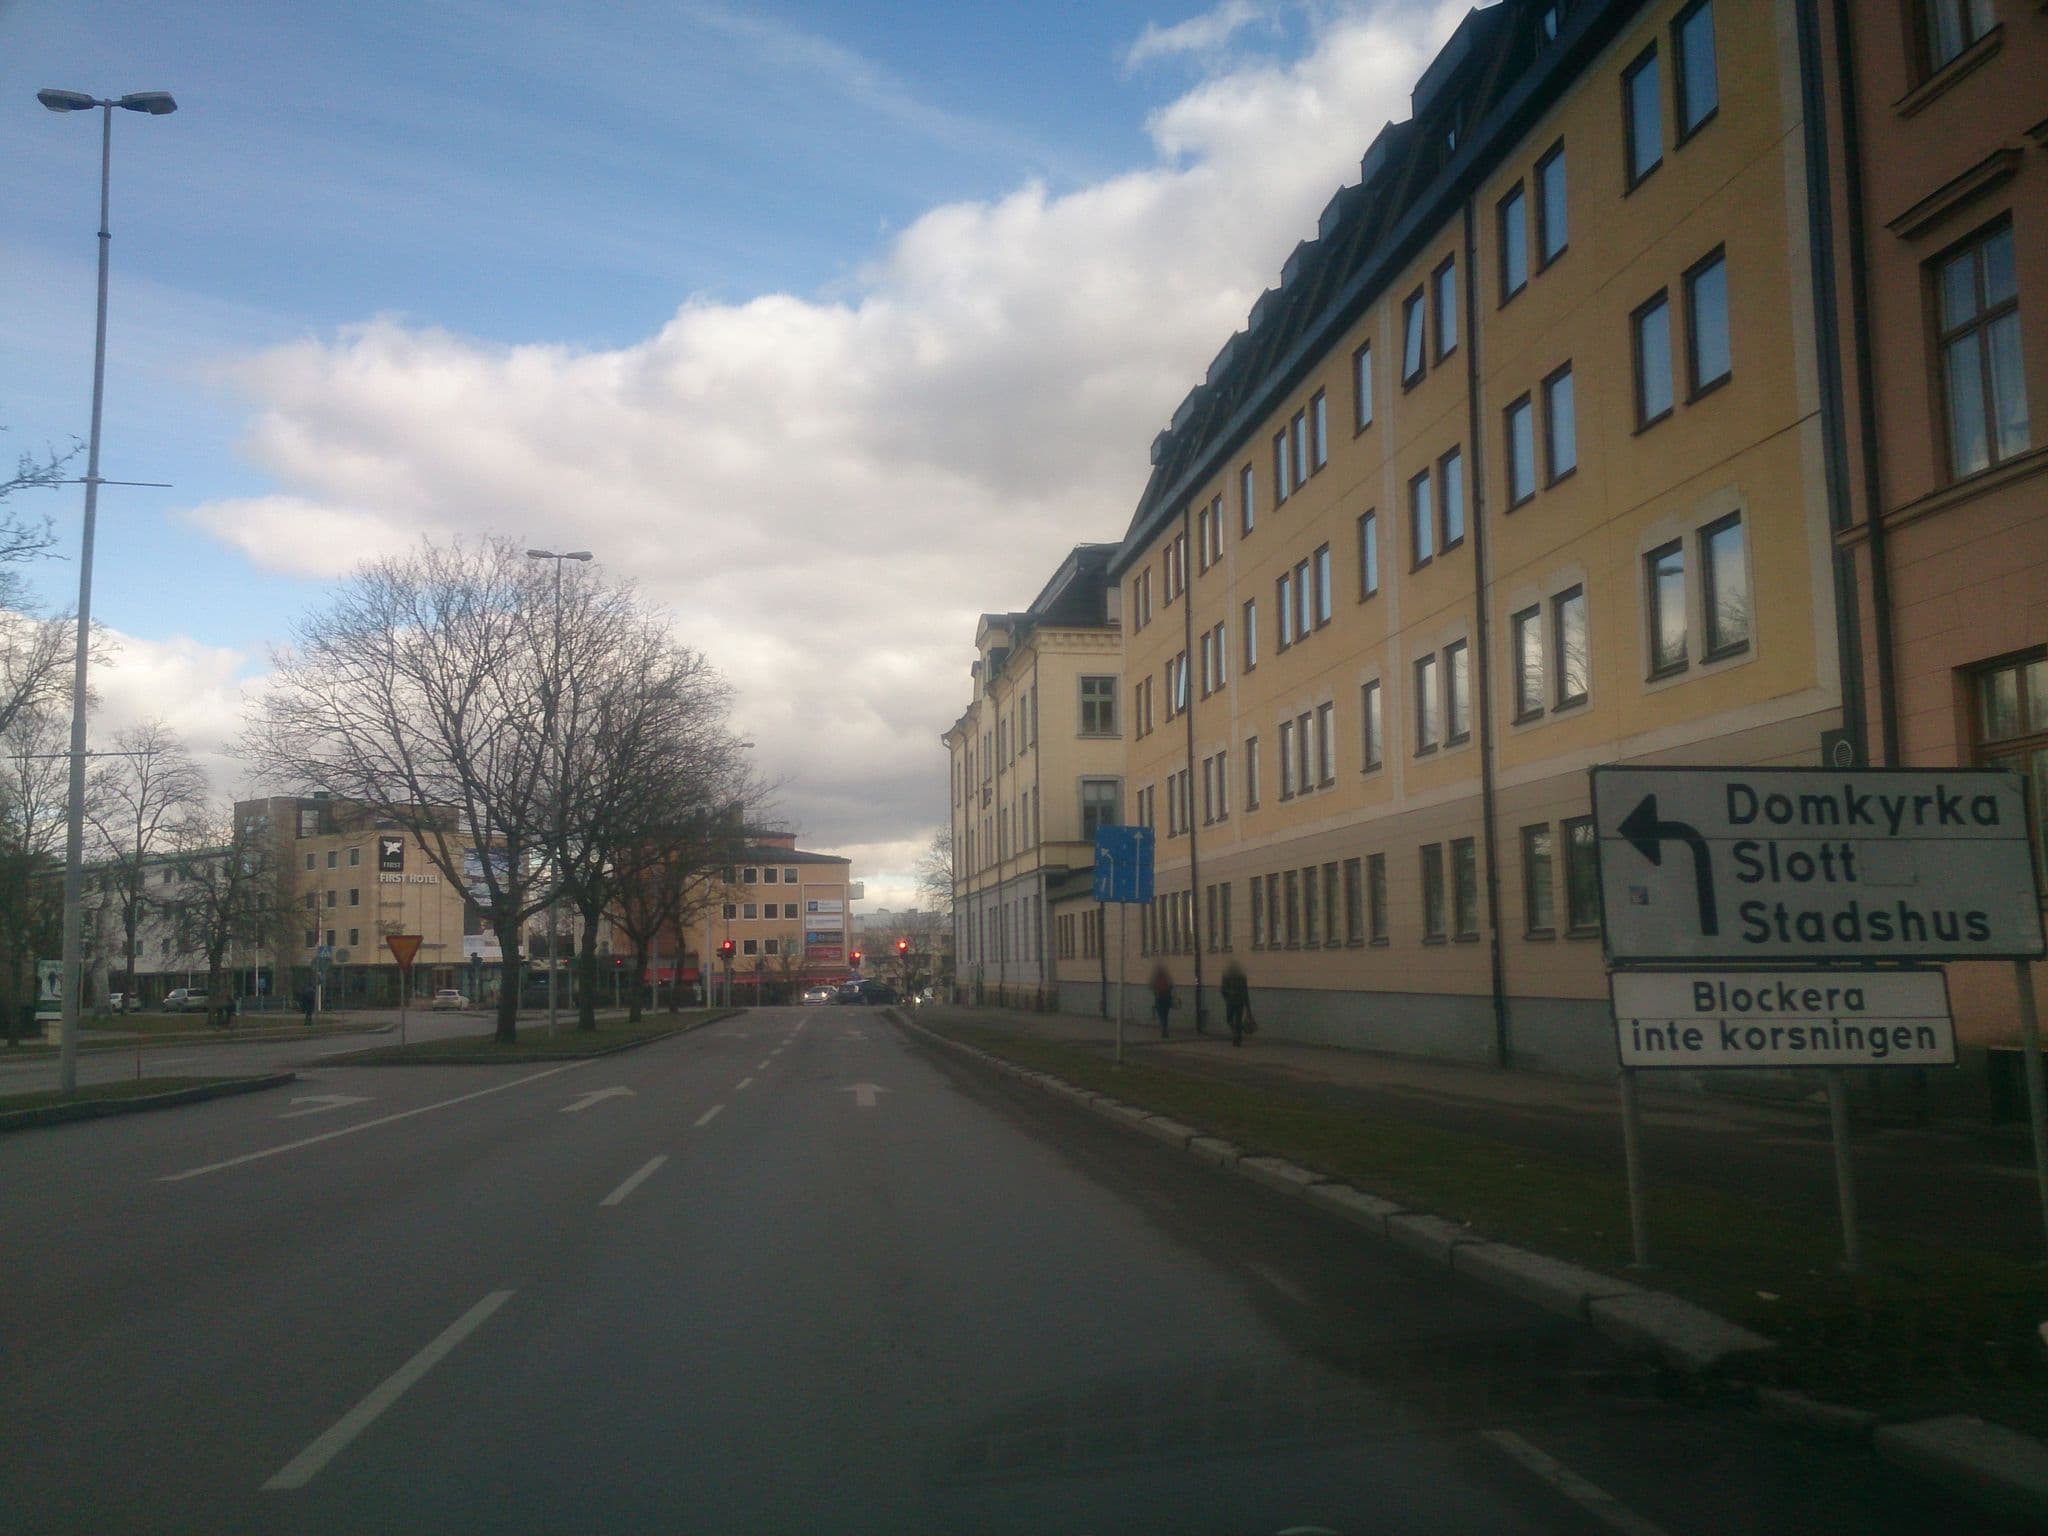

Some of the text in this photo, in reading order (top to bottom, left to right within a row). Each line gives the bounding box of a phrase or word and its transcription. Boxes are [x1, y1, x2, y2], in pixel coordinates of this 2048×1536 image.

[1726, 783, 1999, 836] Domkyrka
[380, 873, 441, 885] FIRST HOTEL
[1733, 842, 1857, 884] Slott
[1741, 901, 1991, 944] Stadshus
[1694, 982, 1865, 1012] Blockera
[1633, 1019, 1936, 1058] inte korsningen
